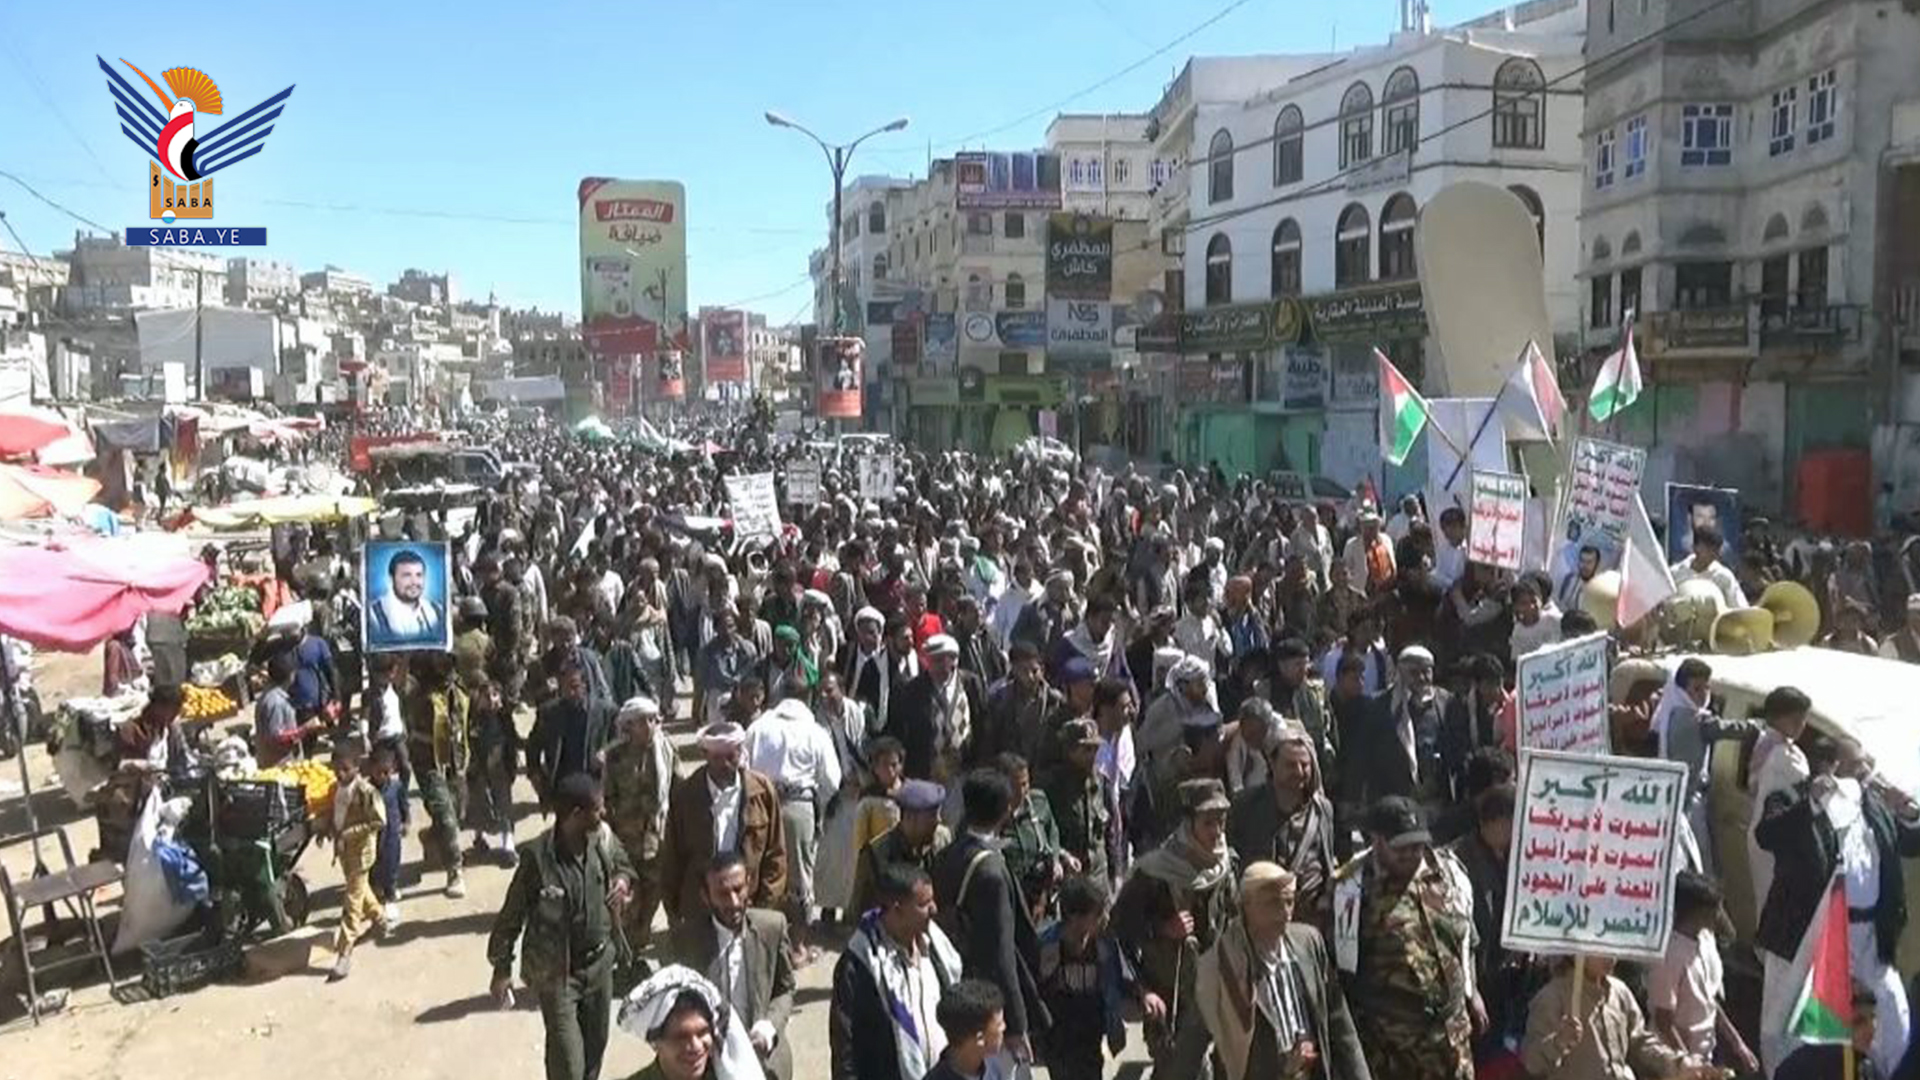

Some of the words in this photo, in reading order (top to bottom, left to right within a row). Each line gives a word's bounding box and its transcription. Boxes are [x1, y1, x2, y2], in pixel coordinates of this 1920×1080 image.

[604, 202, 664, 218] الممتاز
[1532, 767, 1619, 803] أكبر
[1621, 775, 1672, 805] الله
[1529, 807, 1602, 832] لأمريكا
[1608, 818, 1667, 839] الموت
[1525, 837, 1599, 868] لإسرائيل
[1604, 849, 1663, 870] الموت
[1522, 871, 1573, 893] اليهود
[1579, 877, 1606, 898] على
[1615, 877, 1660, 899] اللعنة
[1518, 898, 1590, 935] للإسلام
[1595, 907, 1658, 936] النصر
